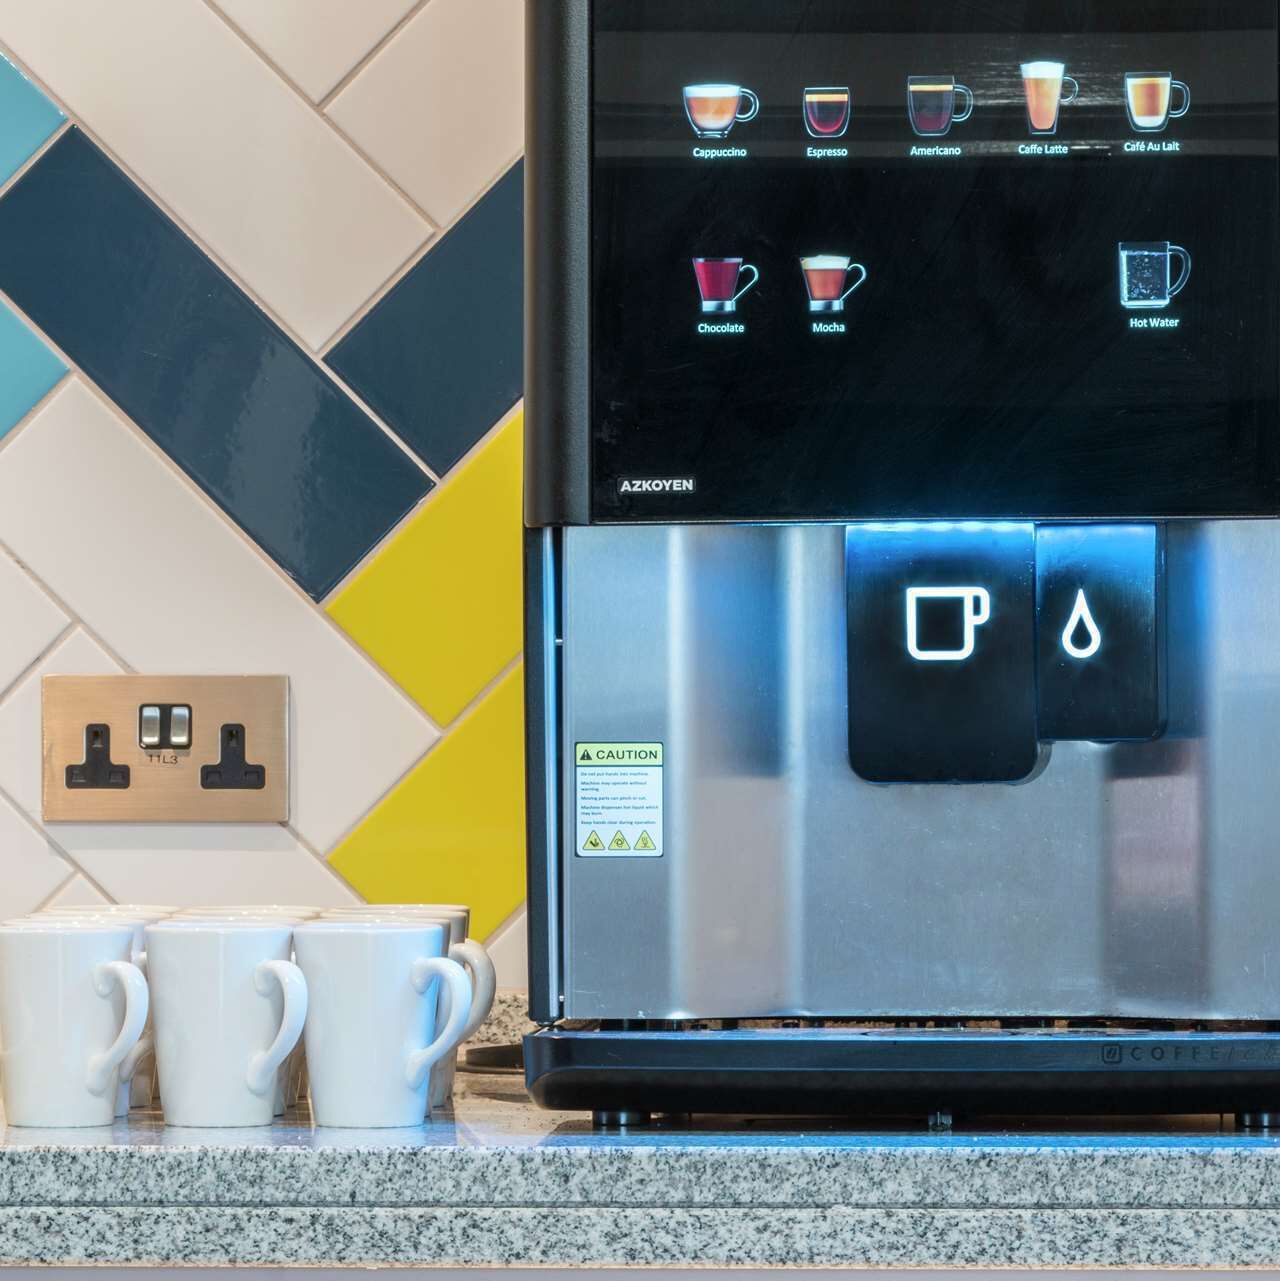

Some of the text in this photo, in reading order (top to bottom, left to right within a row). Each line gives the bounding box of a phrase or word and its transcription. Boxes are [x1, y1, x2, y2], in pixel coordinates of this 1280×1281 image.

[910, 146, 961, 156] Americano
[1018, 144, 1069, 154] Caffe Latte
[1124, 142, 1180, 152] Café Au Lait
[693, 147, 747, 158] Cappuccino
[807, 147, 848, 158] Espresso
[698, 323, 745, 333] Chocolate
[812, 322, 846, 332] Mocha
[1130, 318, 1180, 328] Hot Water
[620, 479, 694, 492] AZKOYEN
[596, 749, 658, 760] CAUTION
